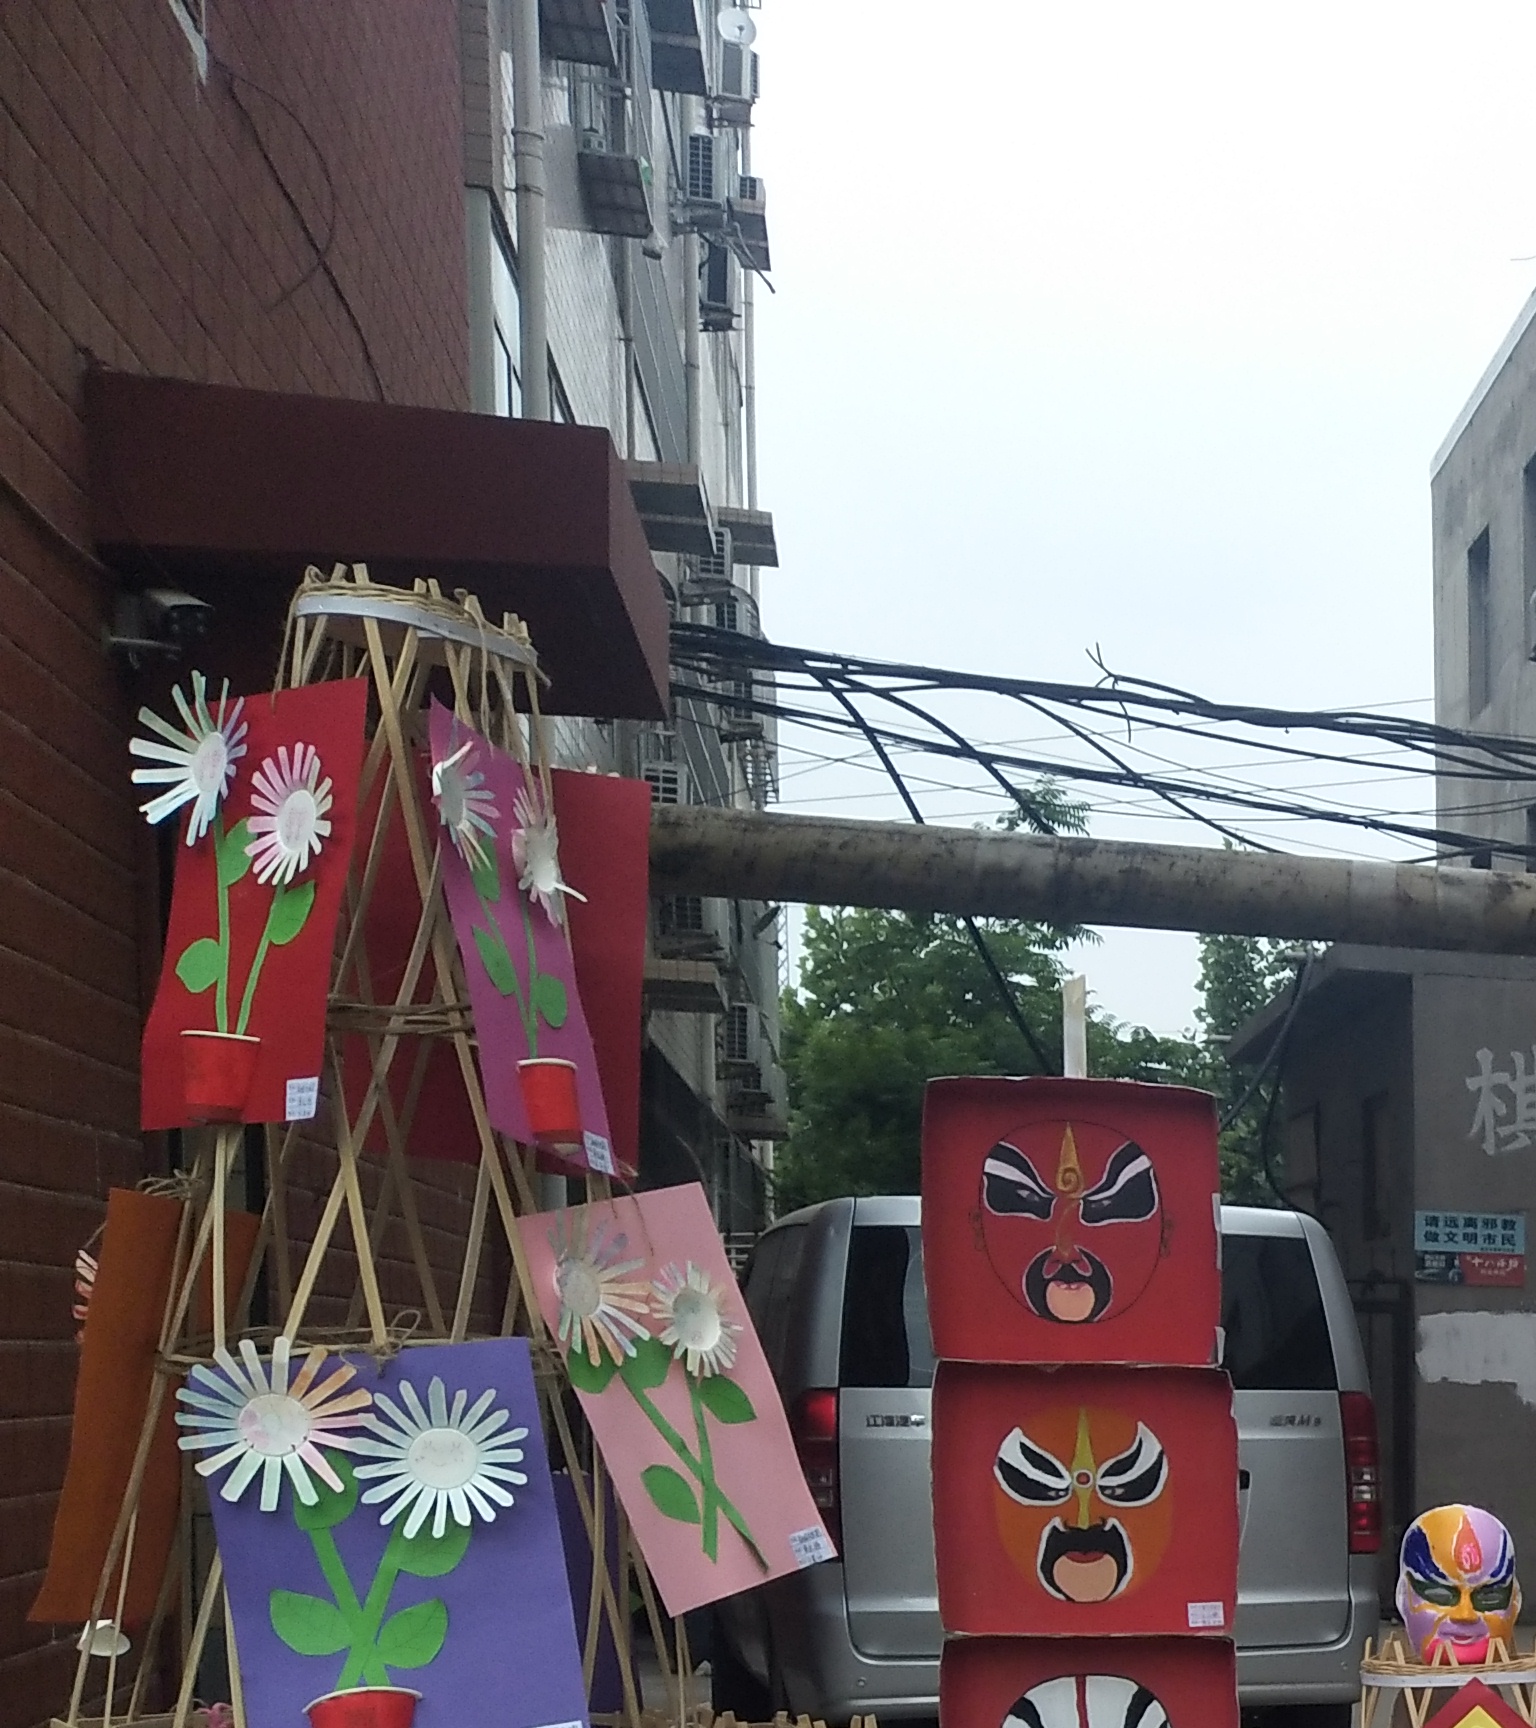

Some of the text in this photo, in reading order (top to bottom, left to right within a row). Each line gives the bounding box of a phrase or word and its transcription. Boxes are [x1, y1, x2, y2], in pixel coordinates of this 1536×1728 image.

[1424, 1215, 1517, 1231] 请远离邪教
[1424, 1230, 1517, 1246] 做文明市民
